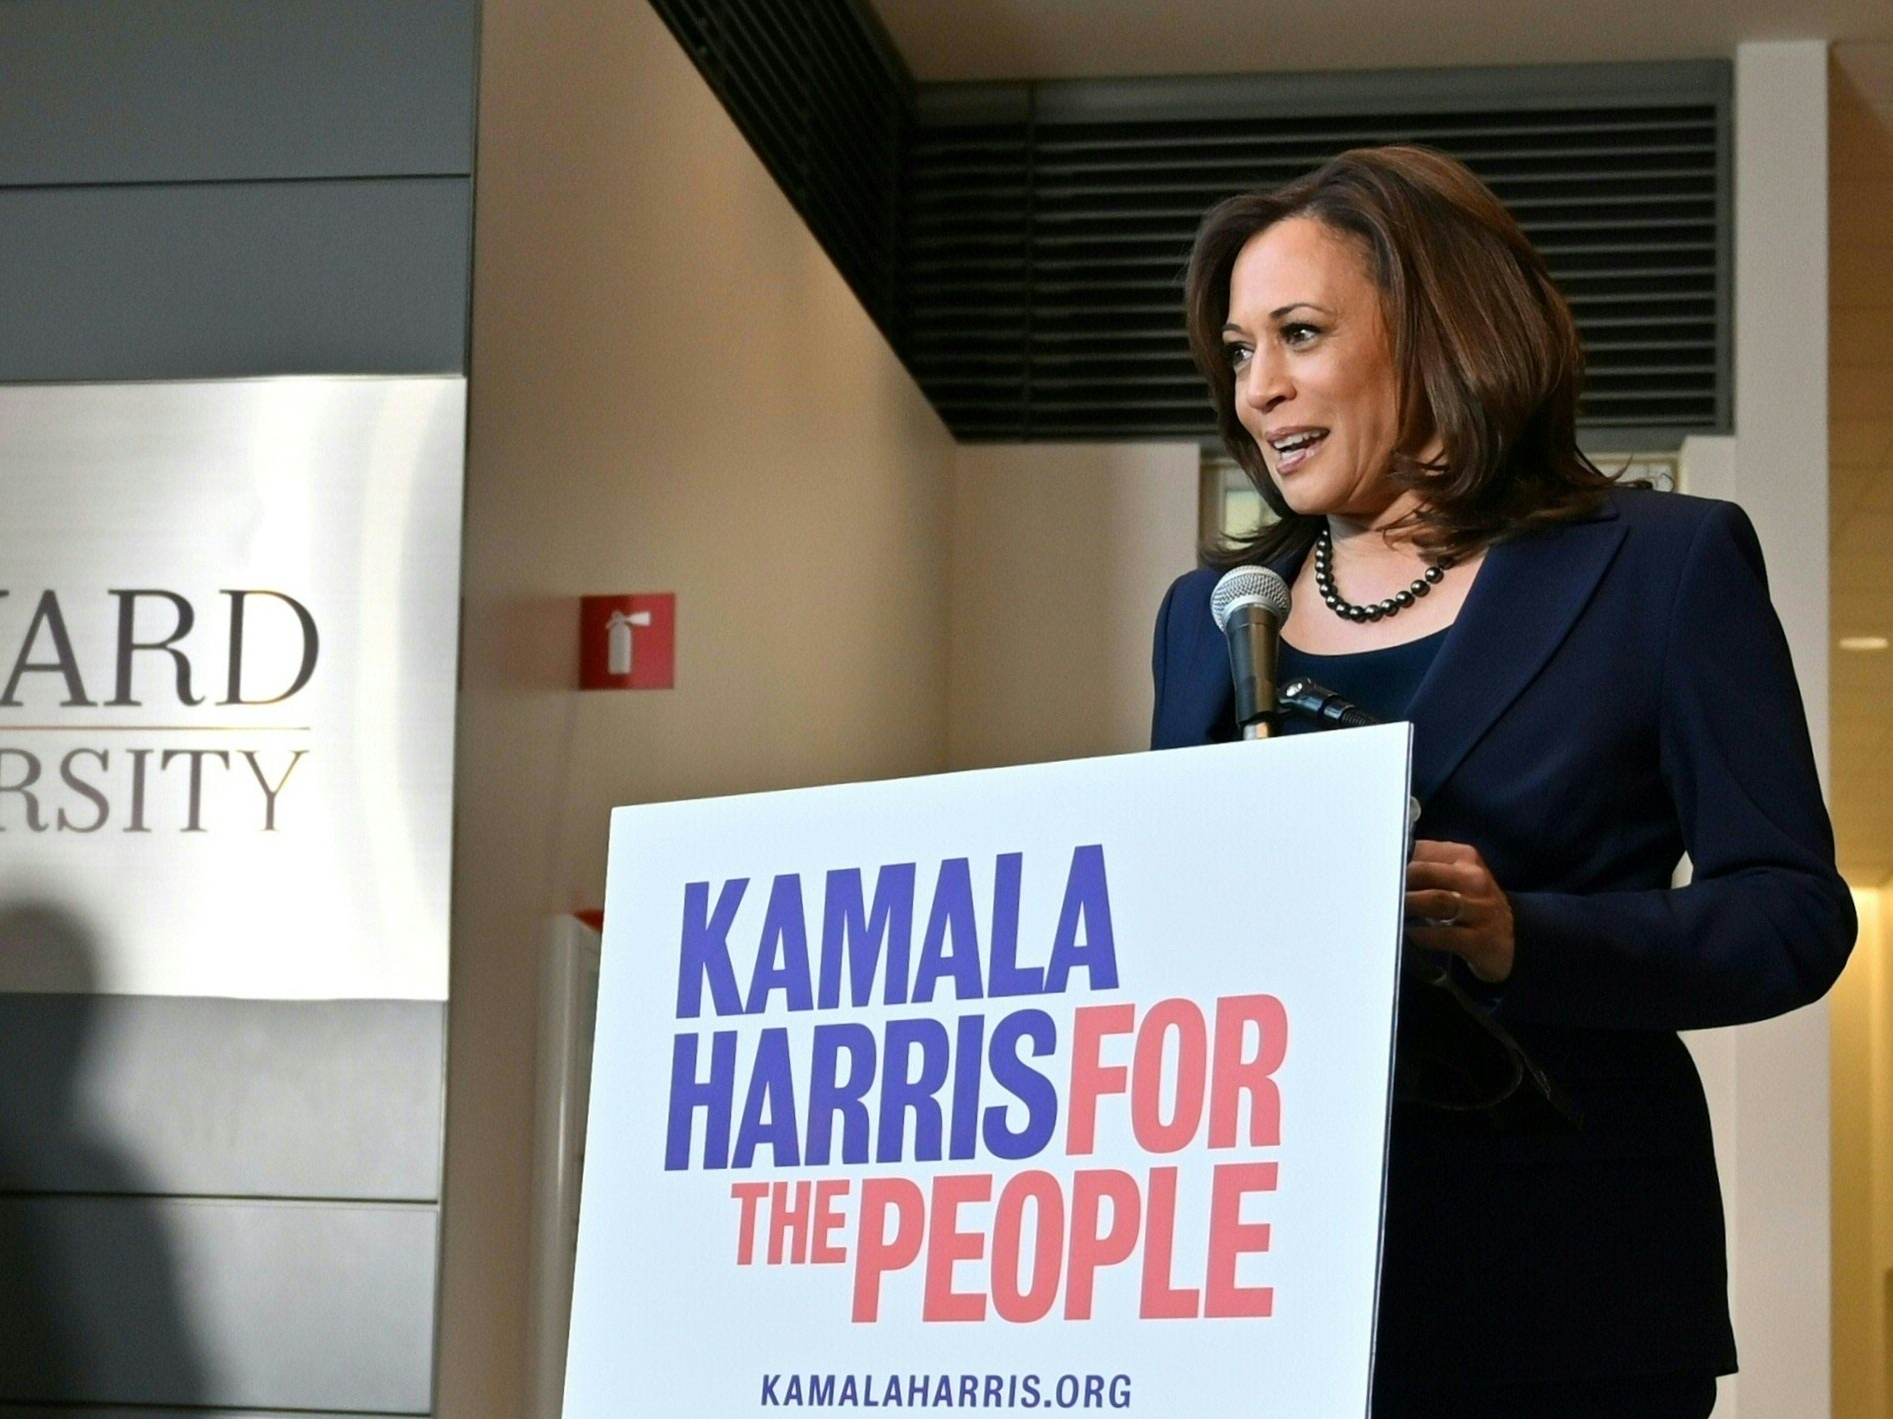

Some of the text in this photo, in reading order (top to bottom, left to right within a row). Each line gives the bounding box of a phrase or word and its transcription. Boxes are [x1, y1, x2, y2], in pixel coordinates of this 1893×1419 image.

[675, 843, 1120, 1019] KAMALA
[664, 994, 1288, 1171] HARRIS FOR
[731, 1162, 1279, 1324] THE PEOPLE
[760, 1374, 1133, 1410] KAMALAHARRIS.ORG
